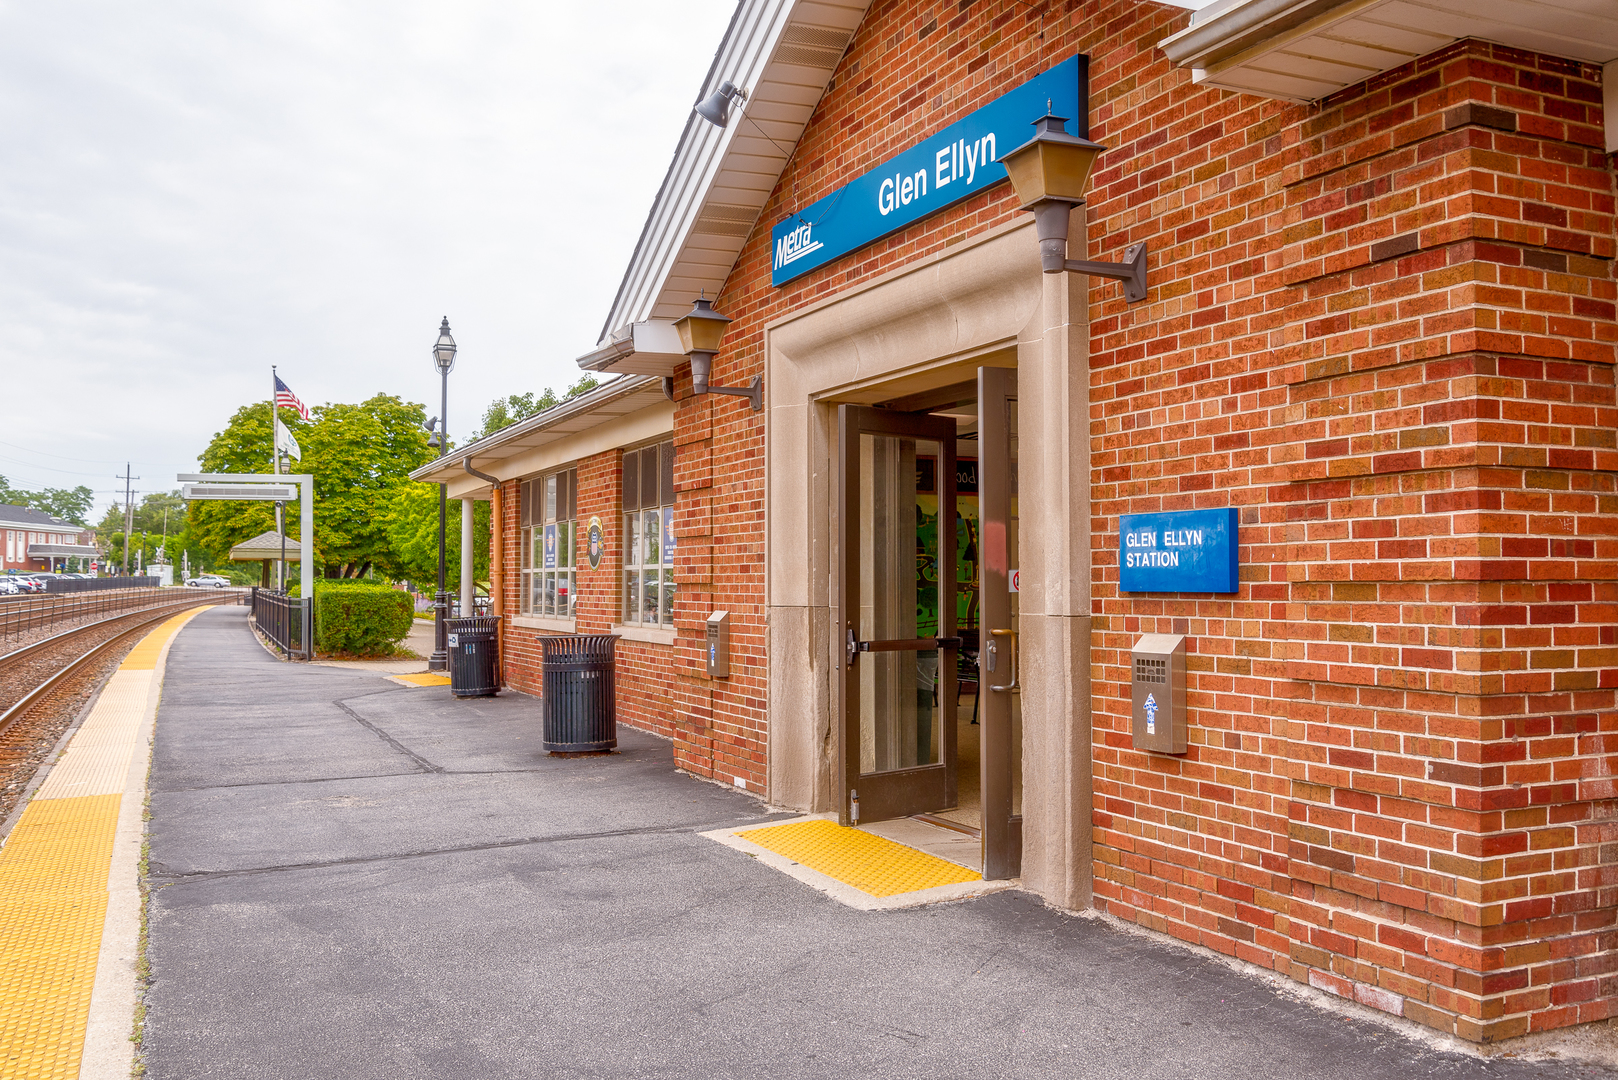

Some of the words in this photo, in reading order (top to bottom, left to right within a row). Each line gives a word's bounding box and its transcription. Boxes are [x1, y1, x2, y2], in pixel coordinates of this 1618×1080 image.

[878, 168, 927, 216] Glen
[935, 132, 996, 190] Ellyn
[773, 221, 813, 271] Metra
[1126, 531, 1157, 548] GLEN
[1164, 529, 1202, 547] ELLYN
[1126, 551, 1179, 568] STATION
